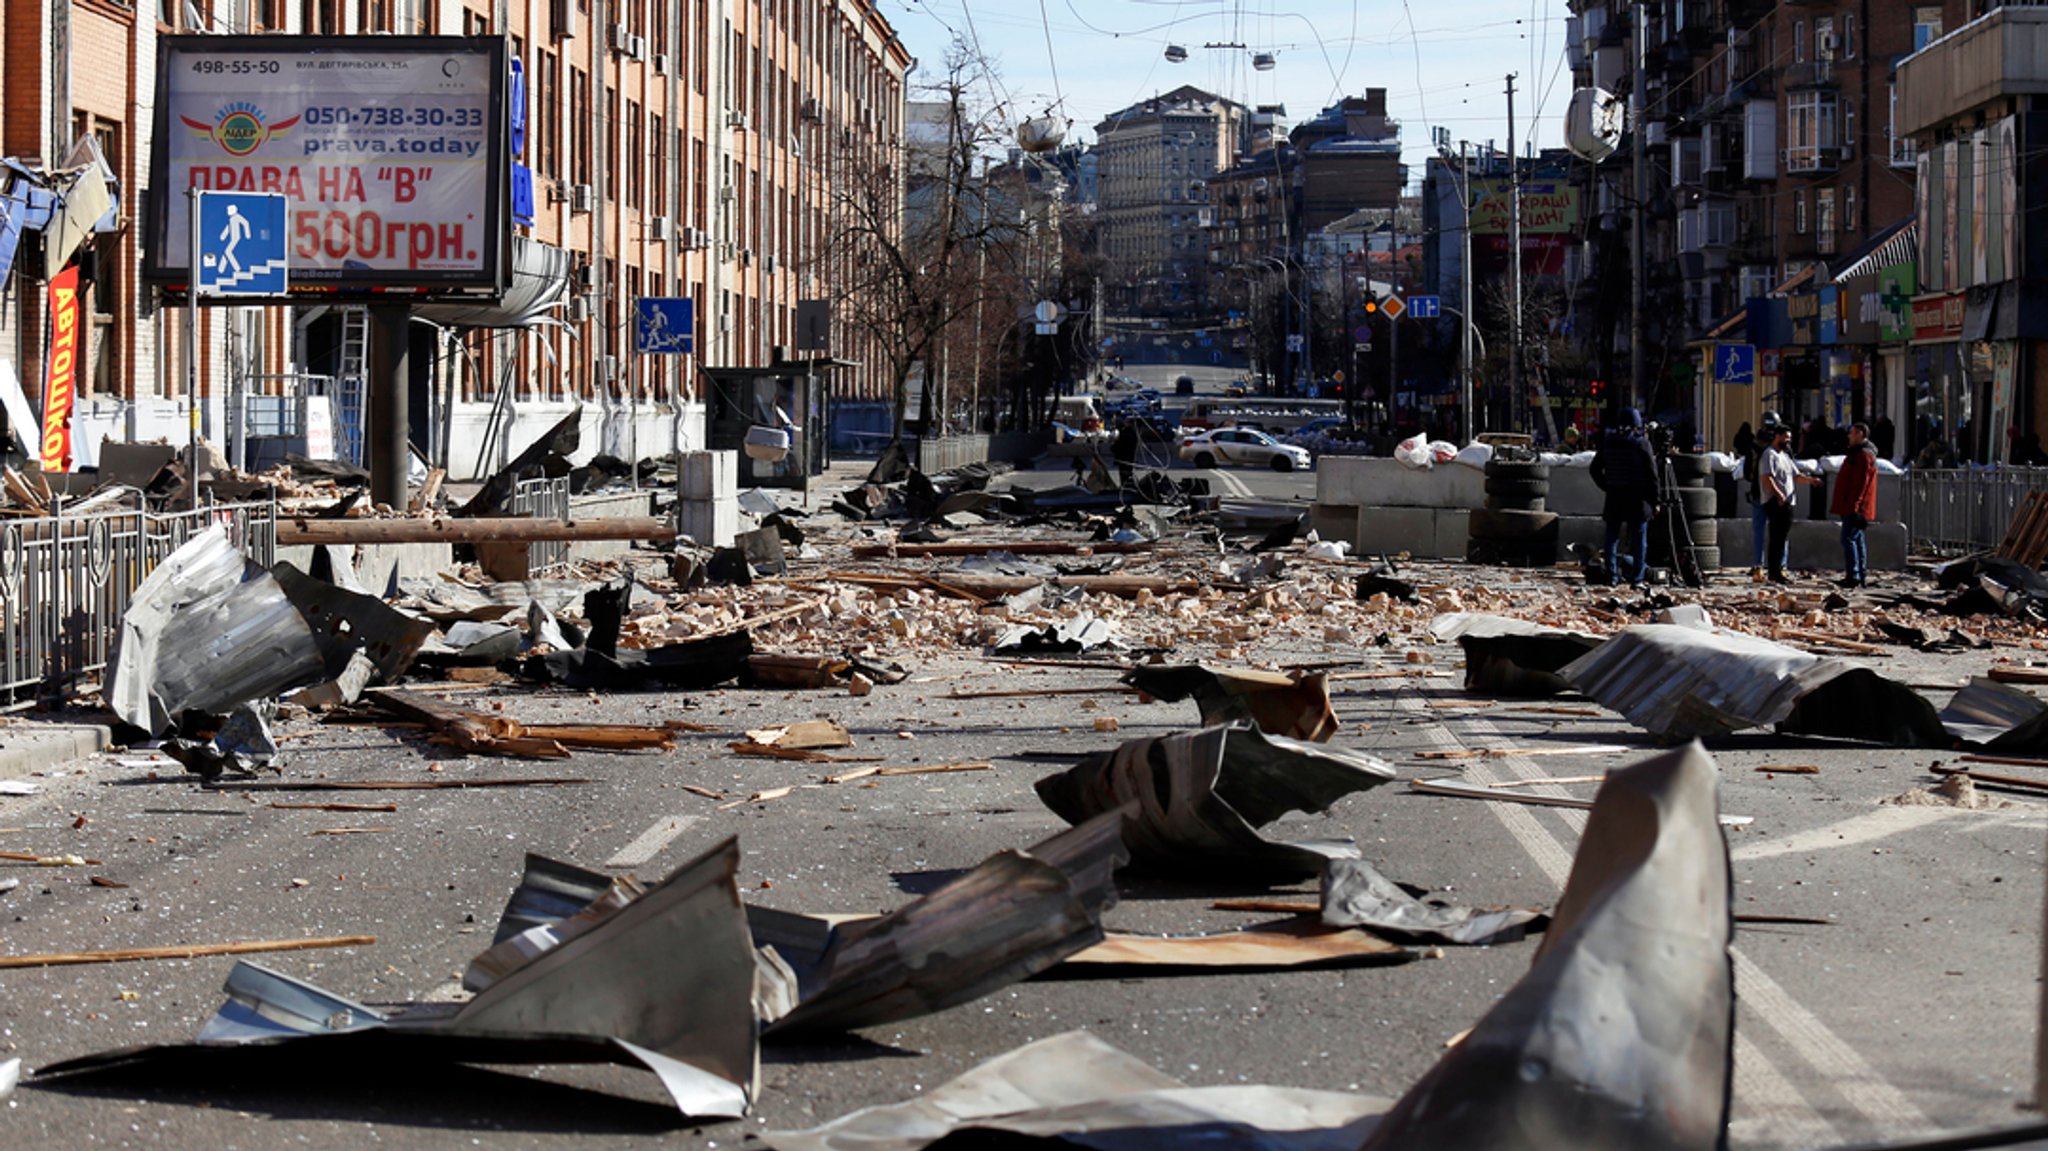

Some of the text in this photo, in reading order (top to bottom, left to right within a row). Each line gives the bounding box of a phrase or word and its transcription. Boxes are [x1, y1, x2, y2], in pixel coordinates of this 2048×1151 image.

[192, 60, 280, 73] 498-55-50
[223, 128, 257, 138] ЛІДЕР
[303, 137, 481, 158] prava.today
[188, 166, 305, 202] ПРАВА
[319, 167, 368, 202] НА
[290, 269, 343, 279] BigBoard
